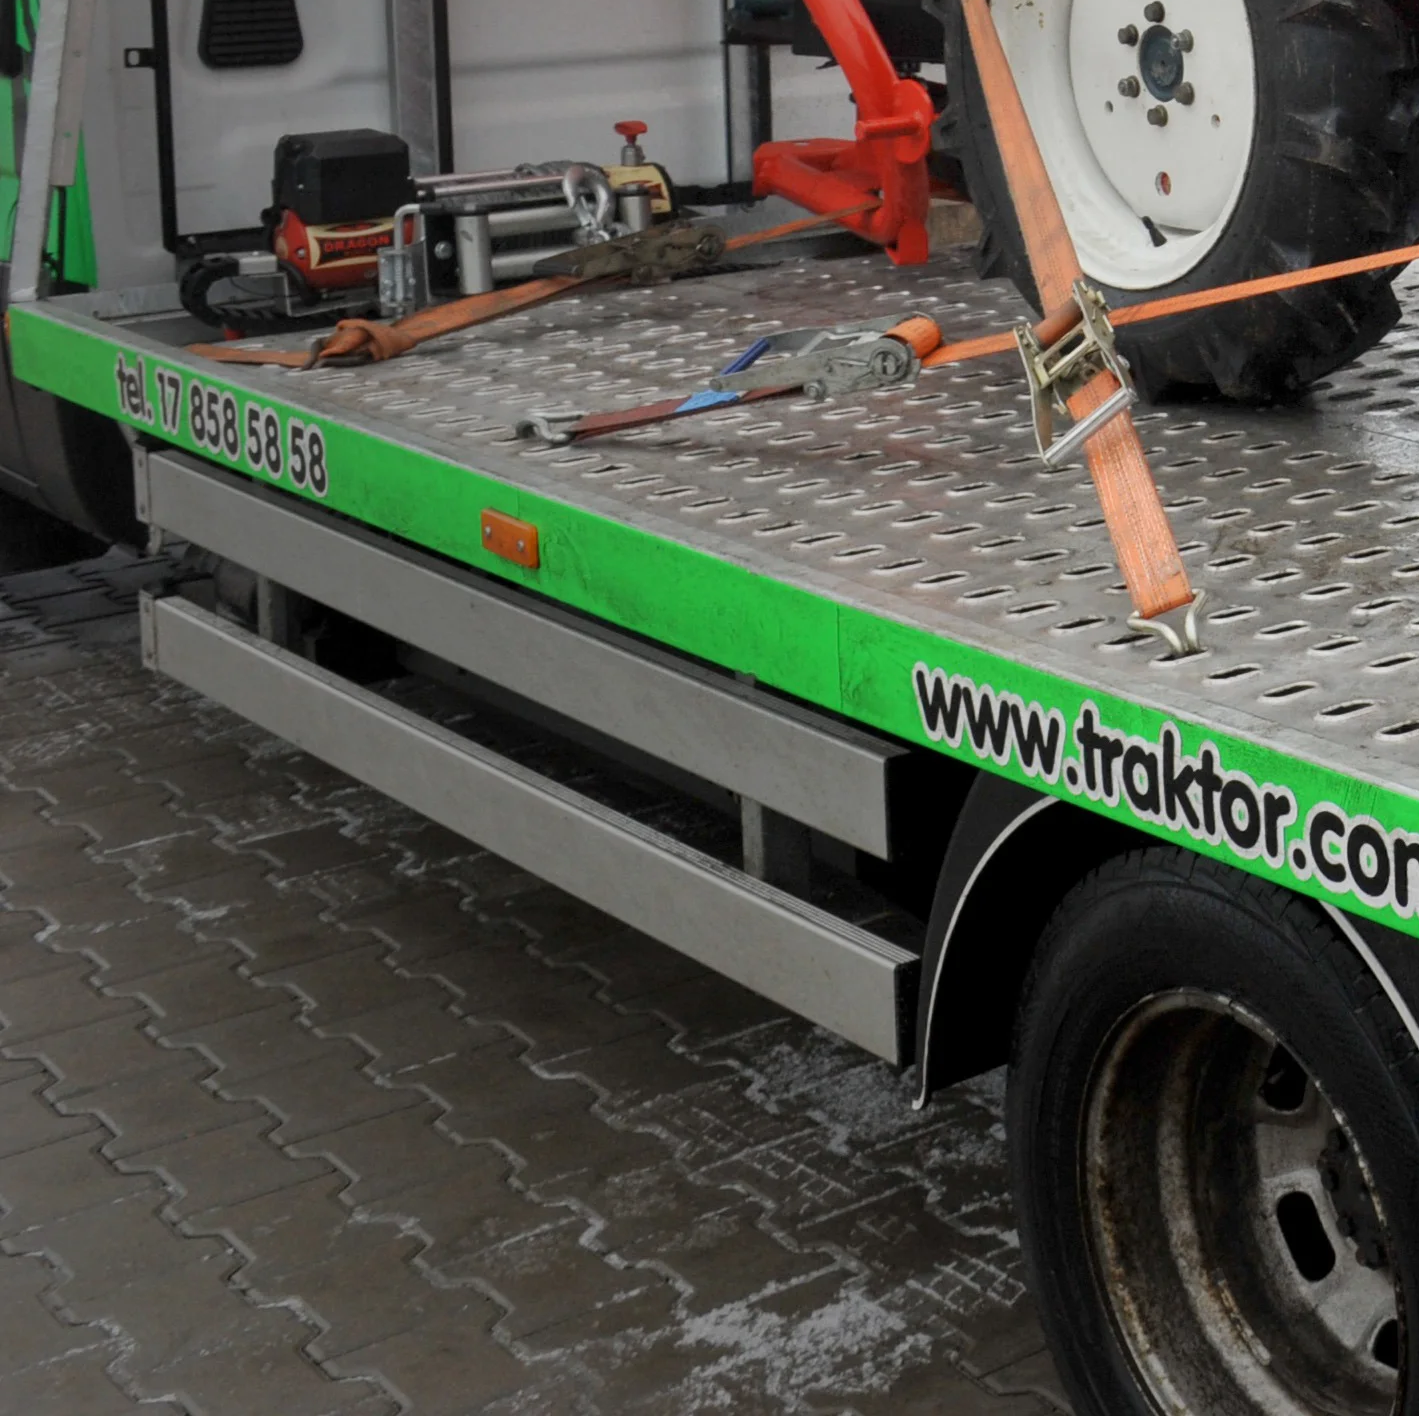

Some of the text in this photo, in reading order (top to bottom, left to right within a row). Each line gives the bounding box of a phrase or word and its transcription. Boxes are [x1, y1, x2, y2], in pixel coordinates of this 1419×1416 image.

[324, 235, 391, 252] DRAGON
[115, 354, 327, 495] tel. 17 858 58 58
